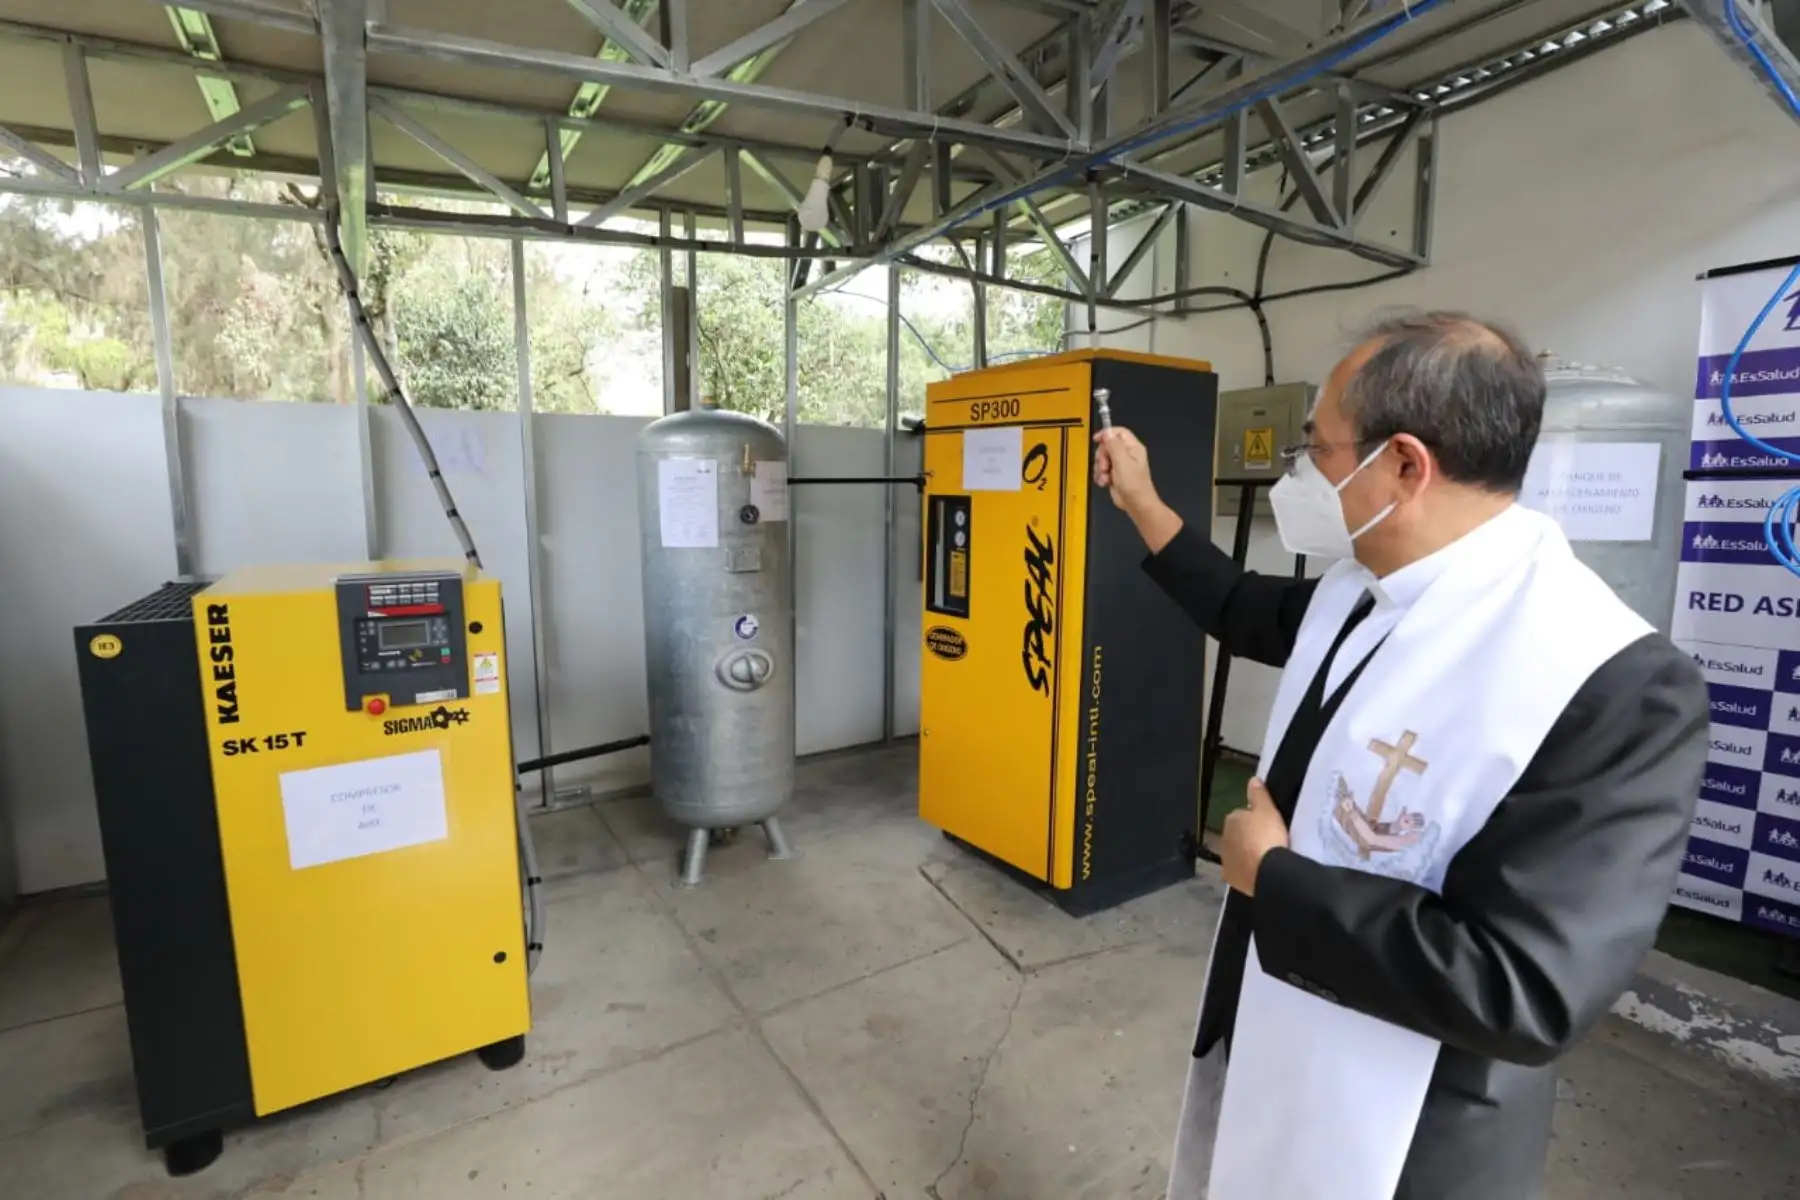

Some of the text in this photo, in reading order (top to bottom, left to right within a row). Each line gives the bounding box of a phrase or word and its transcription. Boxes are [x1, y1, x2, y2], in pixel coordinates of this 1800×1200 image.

[1740, 366, 1800, 383] EsSalud
[970, 398, 1020, 421] SP300
[1736, 411, 1795, 425] EsSalud
[1721, 539, 1769, 551] EsSalu
[1688, 591, 1744, 613] RED
[207, 603, 240, 724] KAESER
[1707, 659, 1764, 676] EsSalud
[1709, 701, 1757, 716] sSalud
[222, 738, 259, 756] SK
[1082, 646, 1102, 880] www.speal-intl.com
